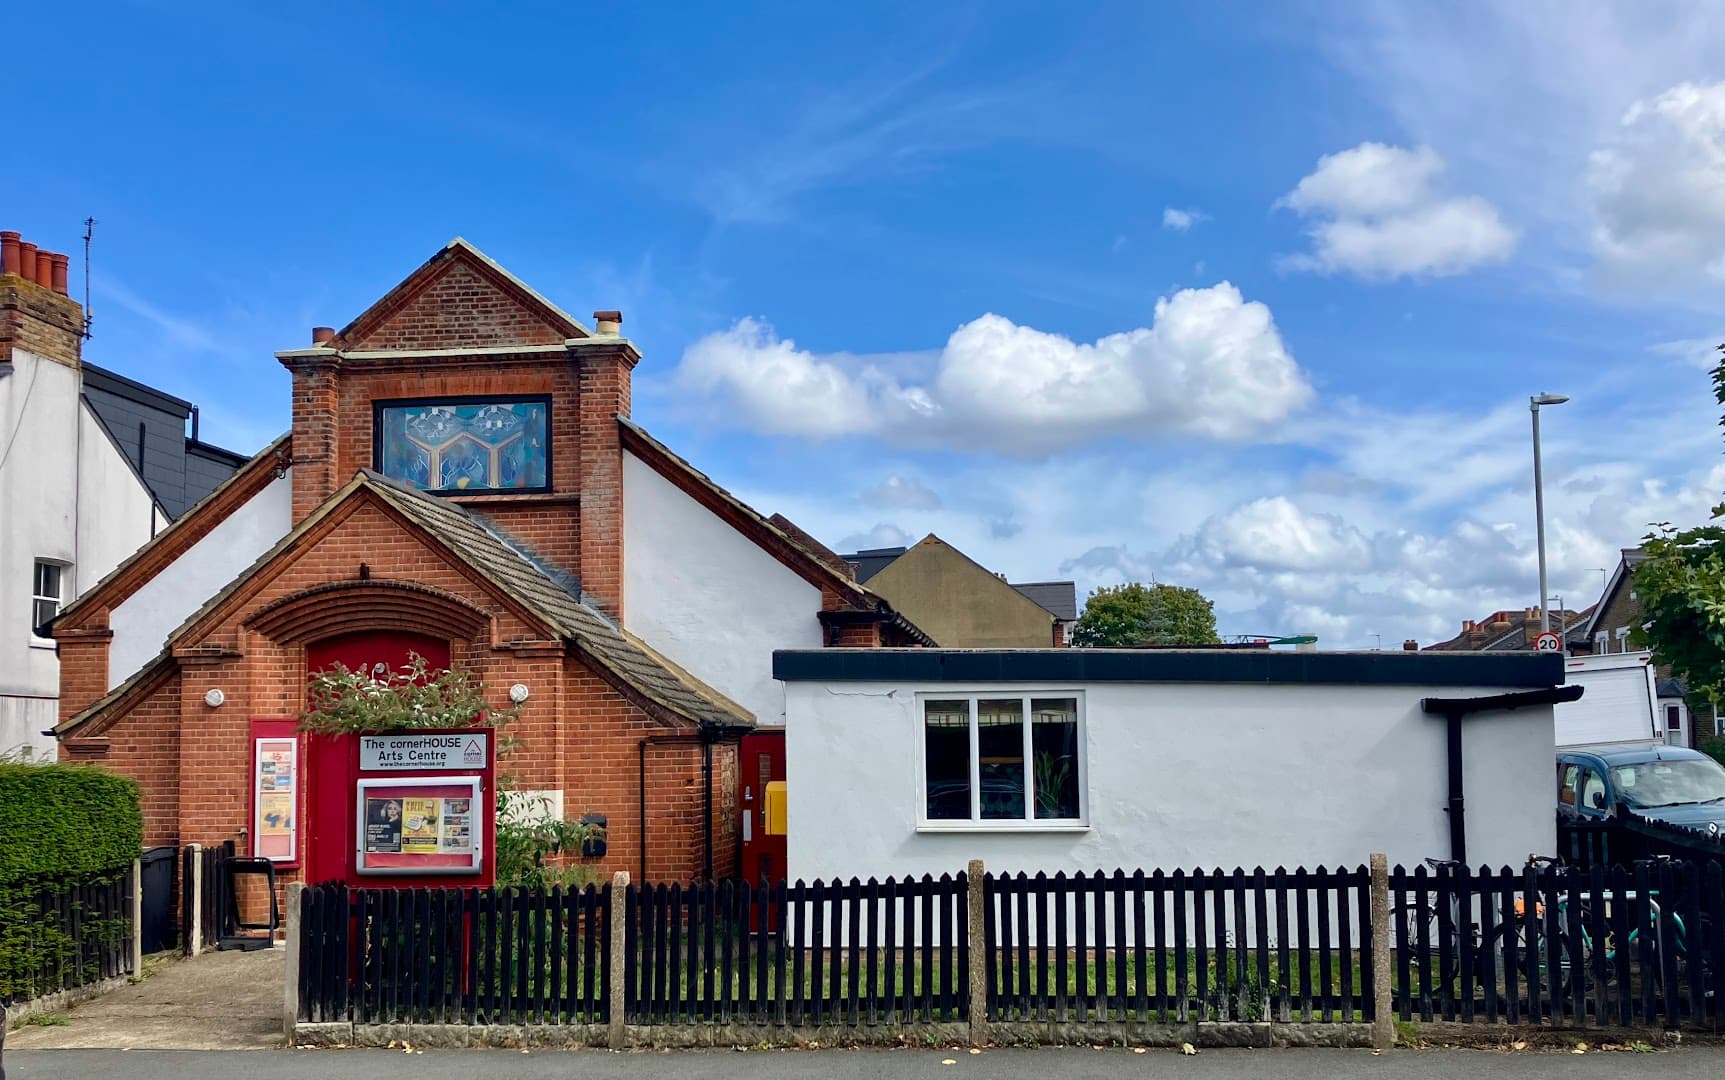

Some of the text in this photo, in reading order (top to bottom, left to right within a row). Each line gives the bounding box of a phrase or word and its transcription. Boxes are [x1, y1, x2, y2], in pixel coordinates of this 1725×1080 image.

[1540, 639, 1557, 649] 20
[364, 737, 461, 749] The cornerHOUSE
[378, 750, 447, 760] Arts Centre
